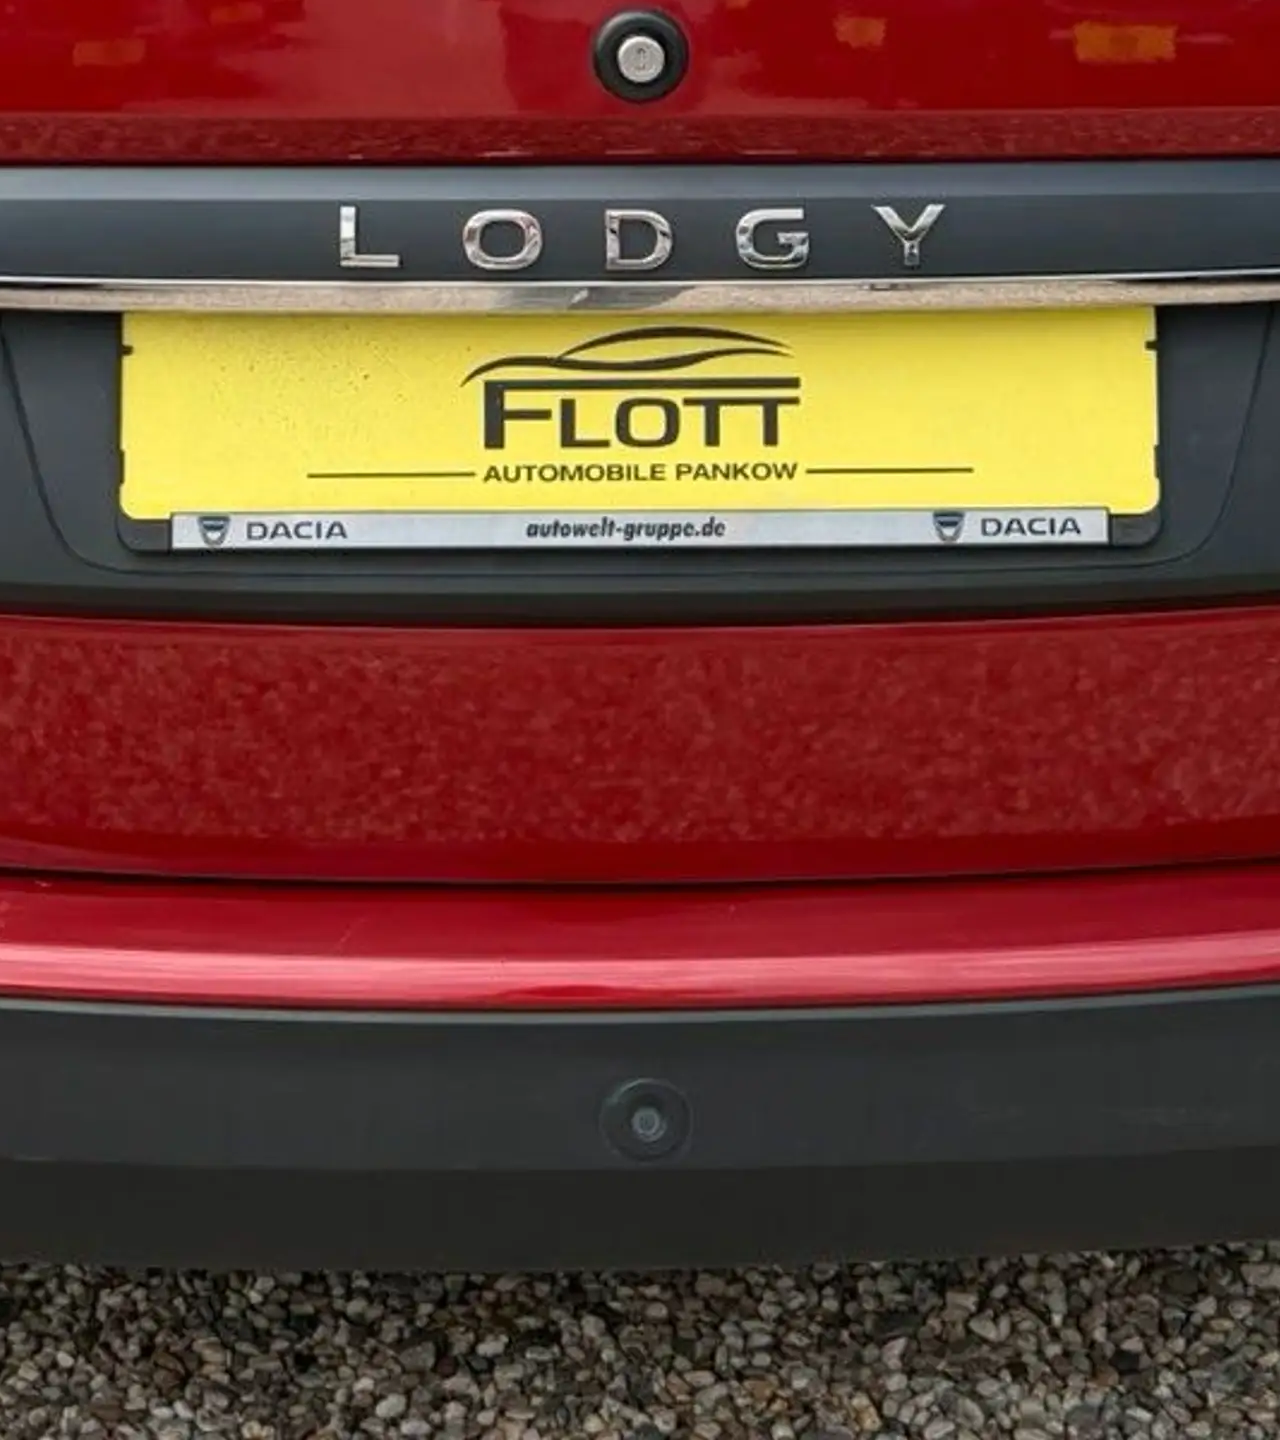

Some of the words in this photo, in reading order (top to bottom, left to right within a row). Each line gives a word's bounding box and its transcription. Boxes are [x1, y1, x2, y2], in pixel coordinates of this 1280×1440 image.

[339, 204, 946, 271] LODGY
[483, 377, 801, 450] FLOTT
[483, 463, 666, 483] AUTOMOBILE
[675, 462, 799, 481] PANKOW
[246, 521, 348, 541] DACIA
[525, 516, 727, 542] autowelt-gruppe.de
[980, 517, 1082, 537] DACIA
